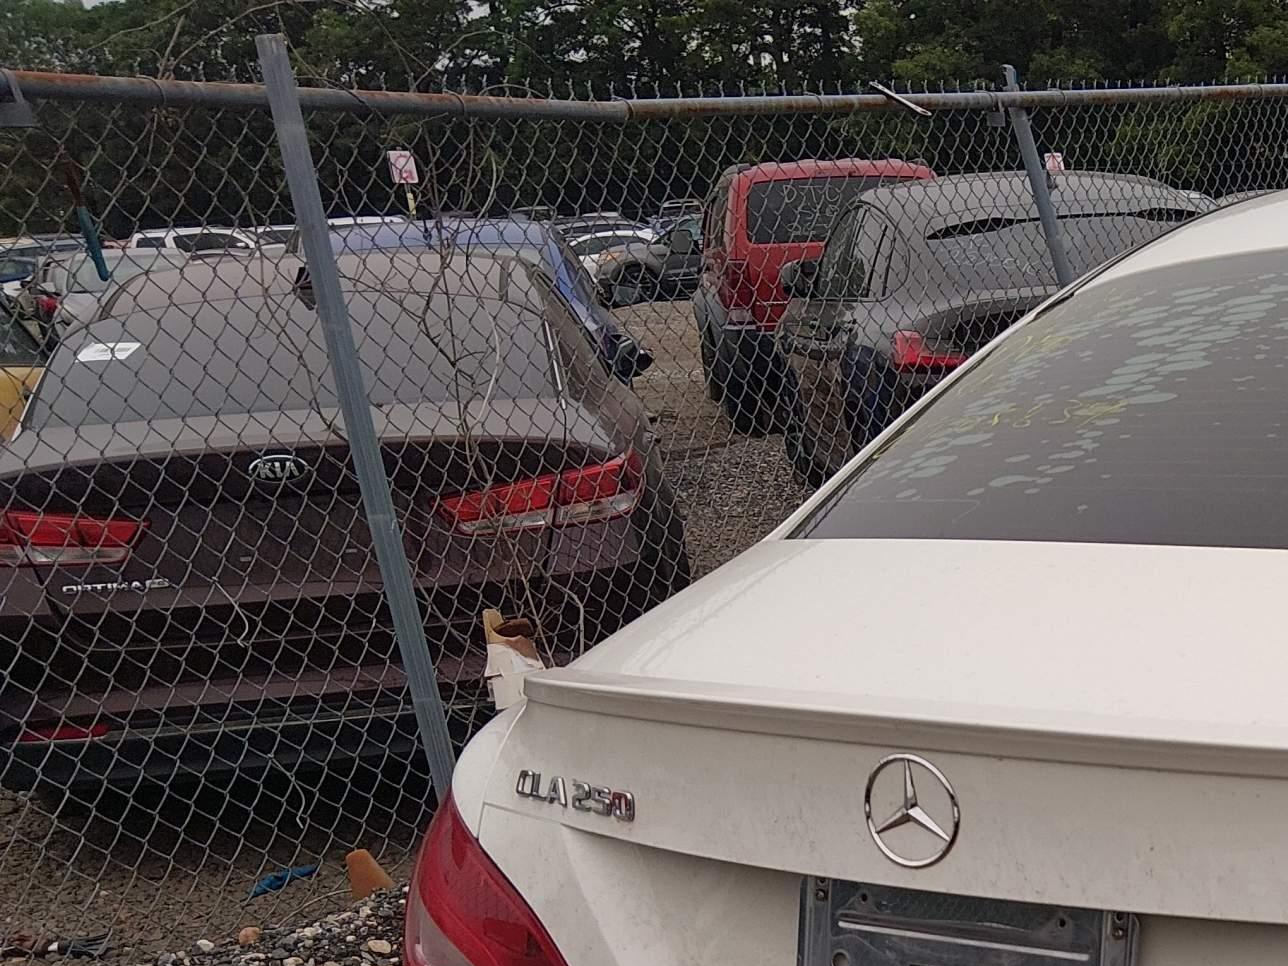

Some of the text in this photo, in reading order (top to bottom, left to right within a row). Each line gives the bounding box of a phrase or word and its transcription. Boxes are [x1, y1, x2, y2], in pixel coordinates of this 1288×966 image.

[257, 461, 300, 479] KIA
[516, 769, 636, 822] CLA 250
